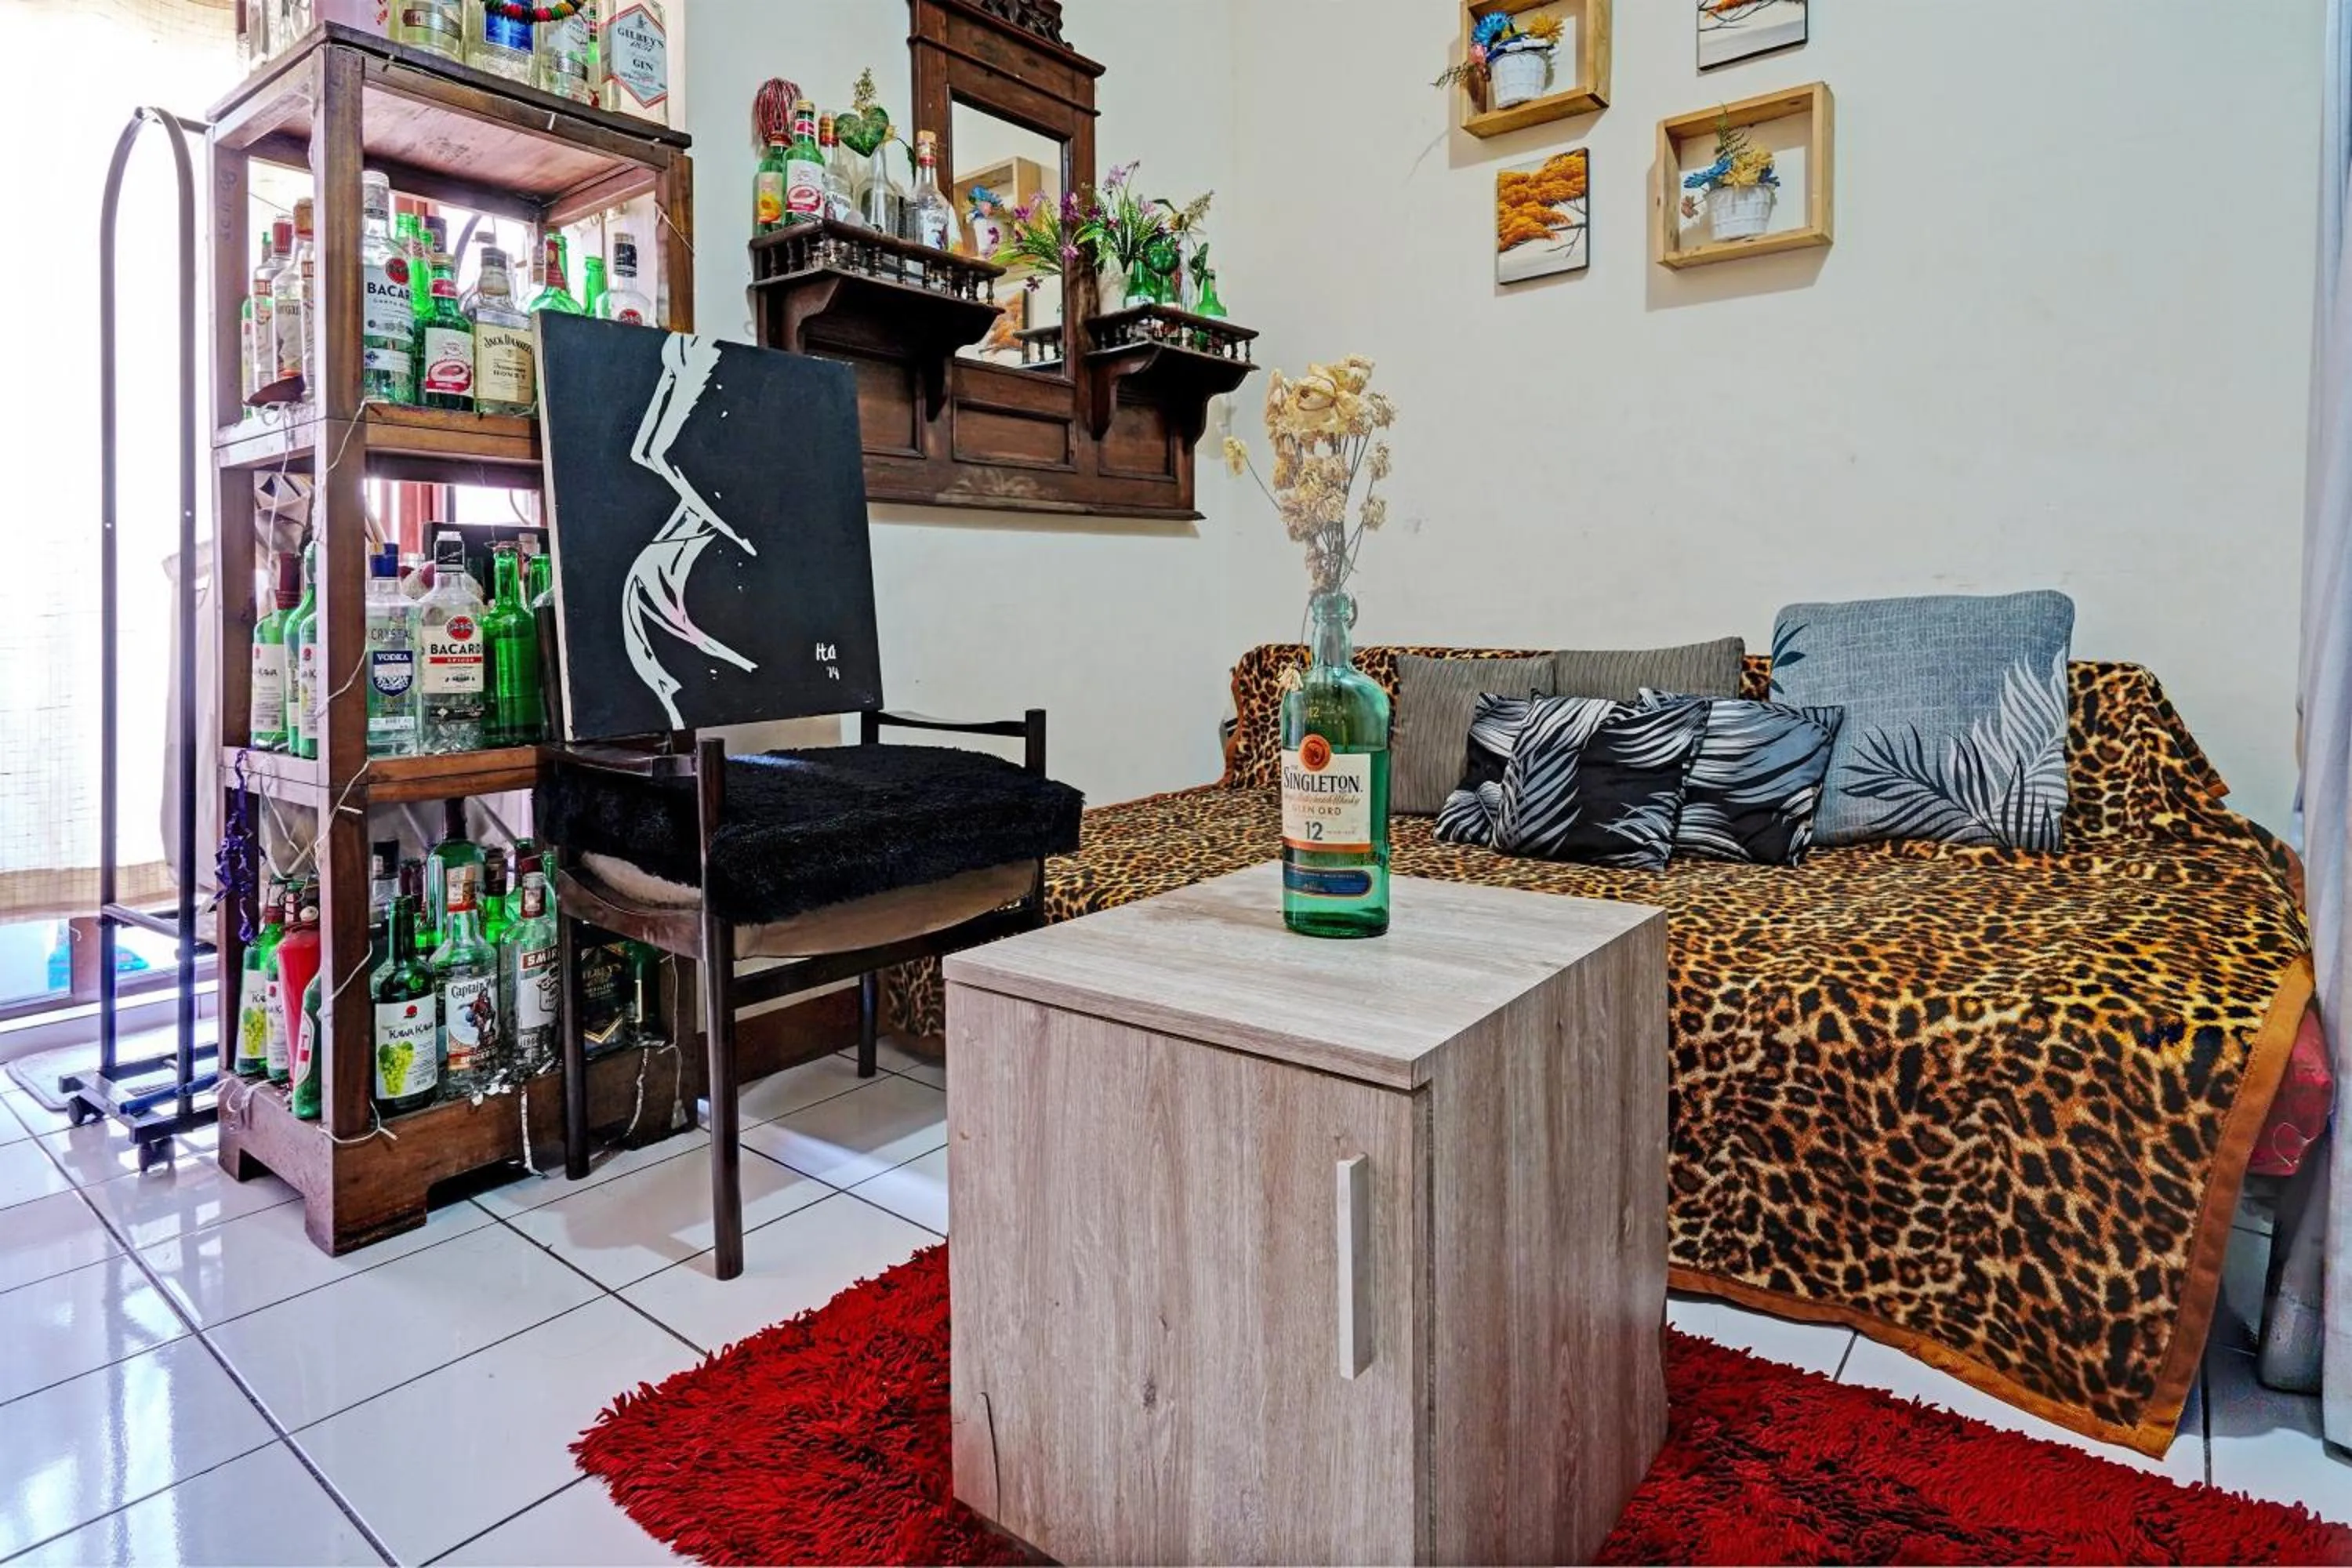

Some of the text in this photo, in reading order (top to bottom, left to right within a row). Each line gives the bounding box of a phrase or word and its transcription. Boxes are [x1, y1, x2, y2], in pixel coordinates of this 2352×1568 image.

[633, 59, 653, 71] GIN
[371, 628, 415, 641] CRYSTAL
[1318, 805, 1341, 816] ORD
[1305, 822, 1323, 840] 12
